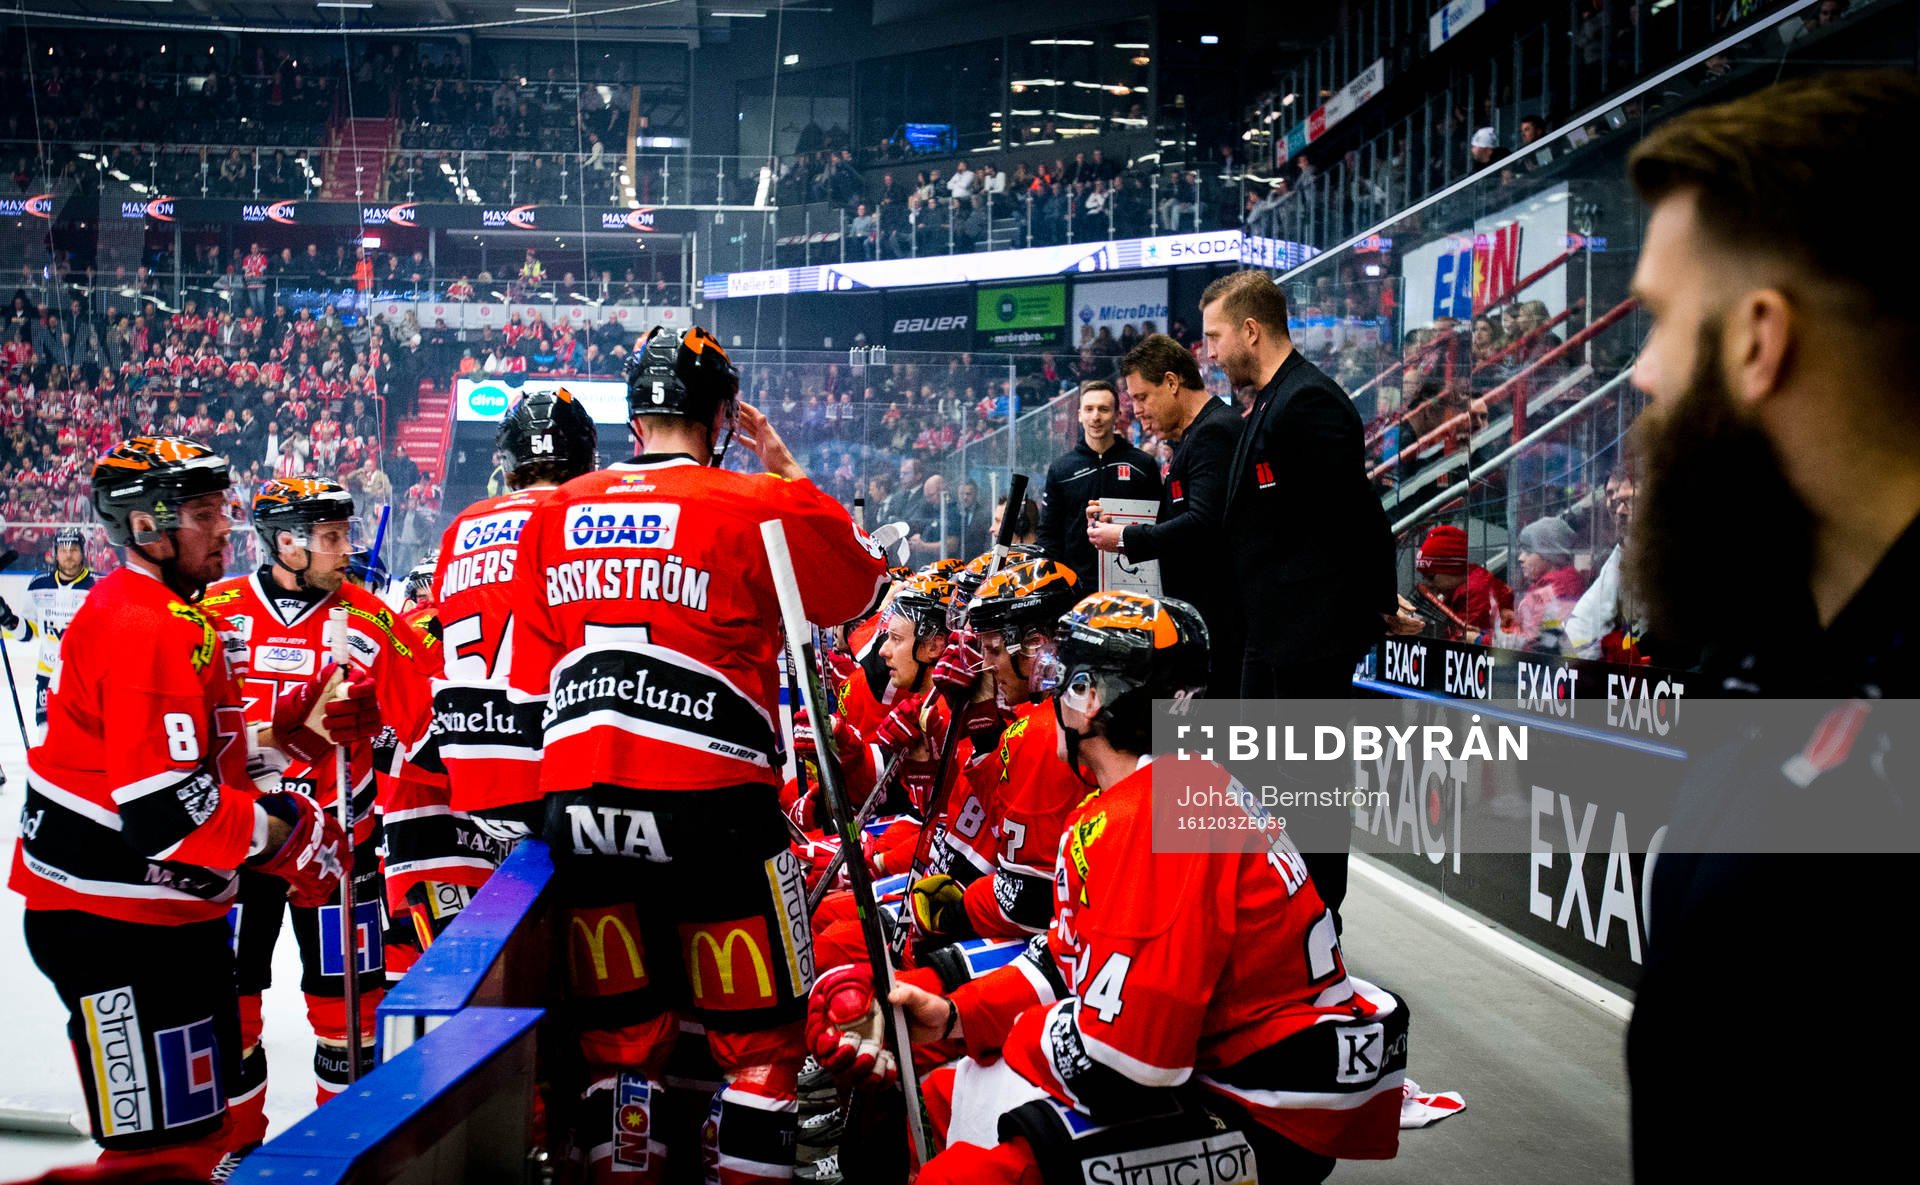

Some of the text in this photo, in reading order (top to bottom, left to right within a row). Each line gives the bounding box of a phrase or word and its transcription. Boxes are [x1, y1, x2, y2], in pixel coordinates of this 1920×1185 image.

[893, 315, 968, 333] BAUER
[1099, 303, 1168, 320] MicroData
[470, 393, 505, 407] dina
[651, 381, 665, 404] 5
[531, 434, 554, 454] 54
[606, 485, 655, 494] BAUER
[573, 506, 662, 546] ÖBAB
[280, 599, 303, 609] SHL
[1011, 599, 1042, 610] BAUER
[264, 647, 303, 662] MOAB
[1385, 641, 1427, 687] EXACT
[1445, 650, 1495, 700] EXACT
[1517, 662, 1578, 718] EXACT
[1607, 674, 1684, 736] EXACT
[164, 712, 200, 761] 8
[709, 741, 758, 761] BAUER
[1354, 722, 1468, 875] EXACT
[956, 795, 987, 838] 8
[565, 804, 673, 864] NA
[29, 860, 68, 883] BAUER
[96, 991, 147, 1131] Structor
[1088, 1141, 1252, 1185] Structor
